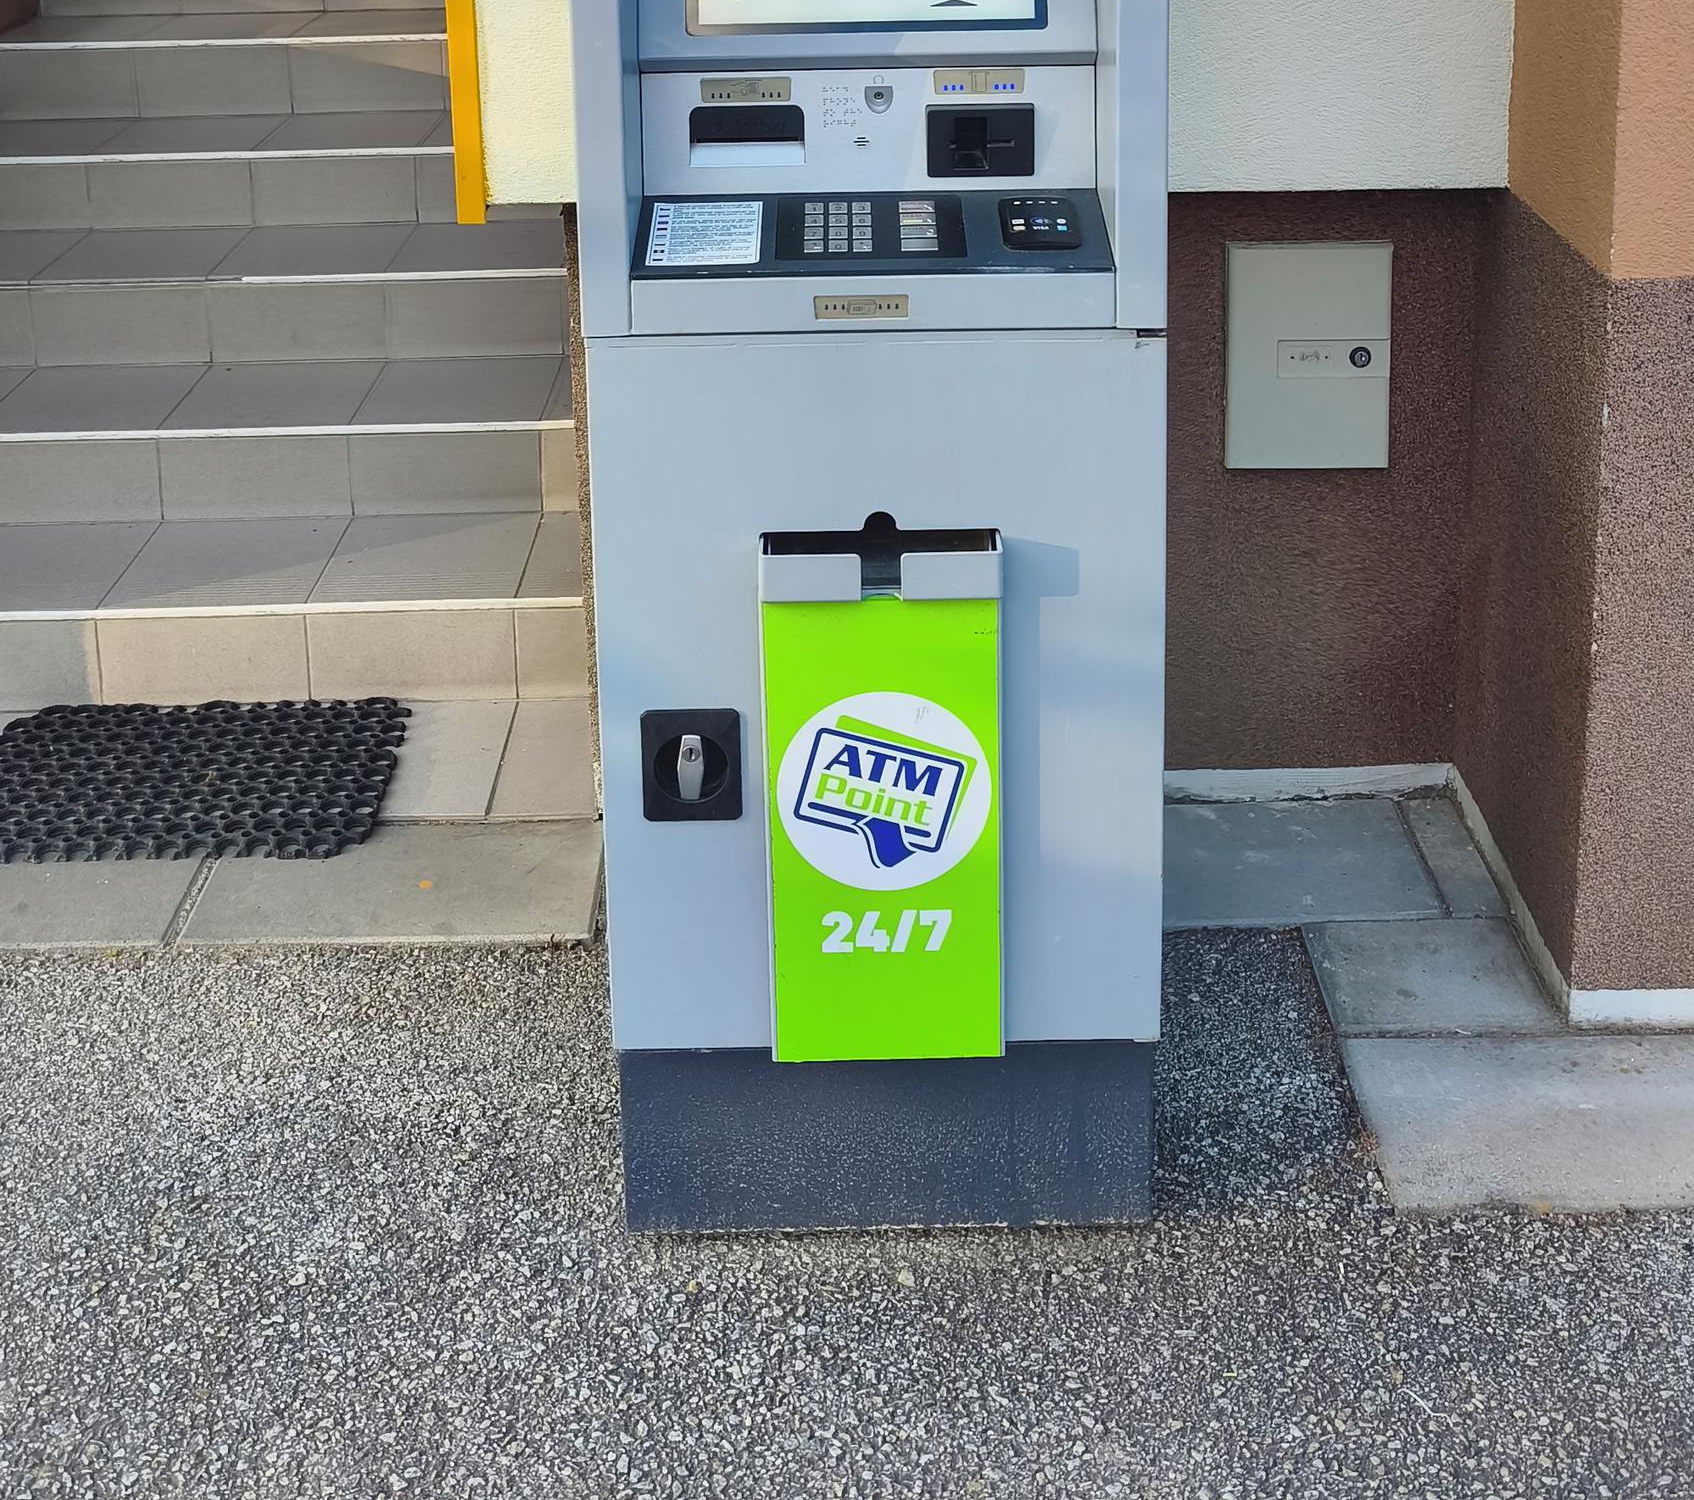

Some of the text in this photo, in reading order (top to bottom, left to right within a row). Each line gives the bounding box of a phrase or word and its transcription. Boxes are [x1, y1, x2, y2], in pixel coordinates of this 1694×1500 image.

[823, 743, 944, 797] ATM
[814, 772, 933, 827] Point
[820, 908, 953, 954] 24/7
